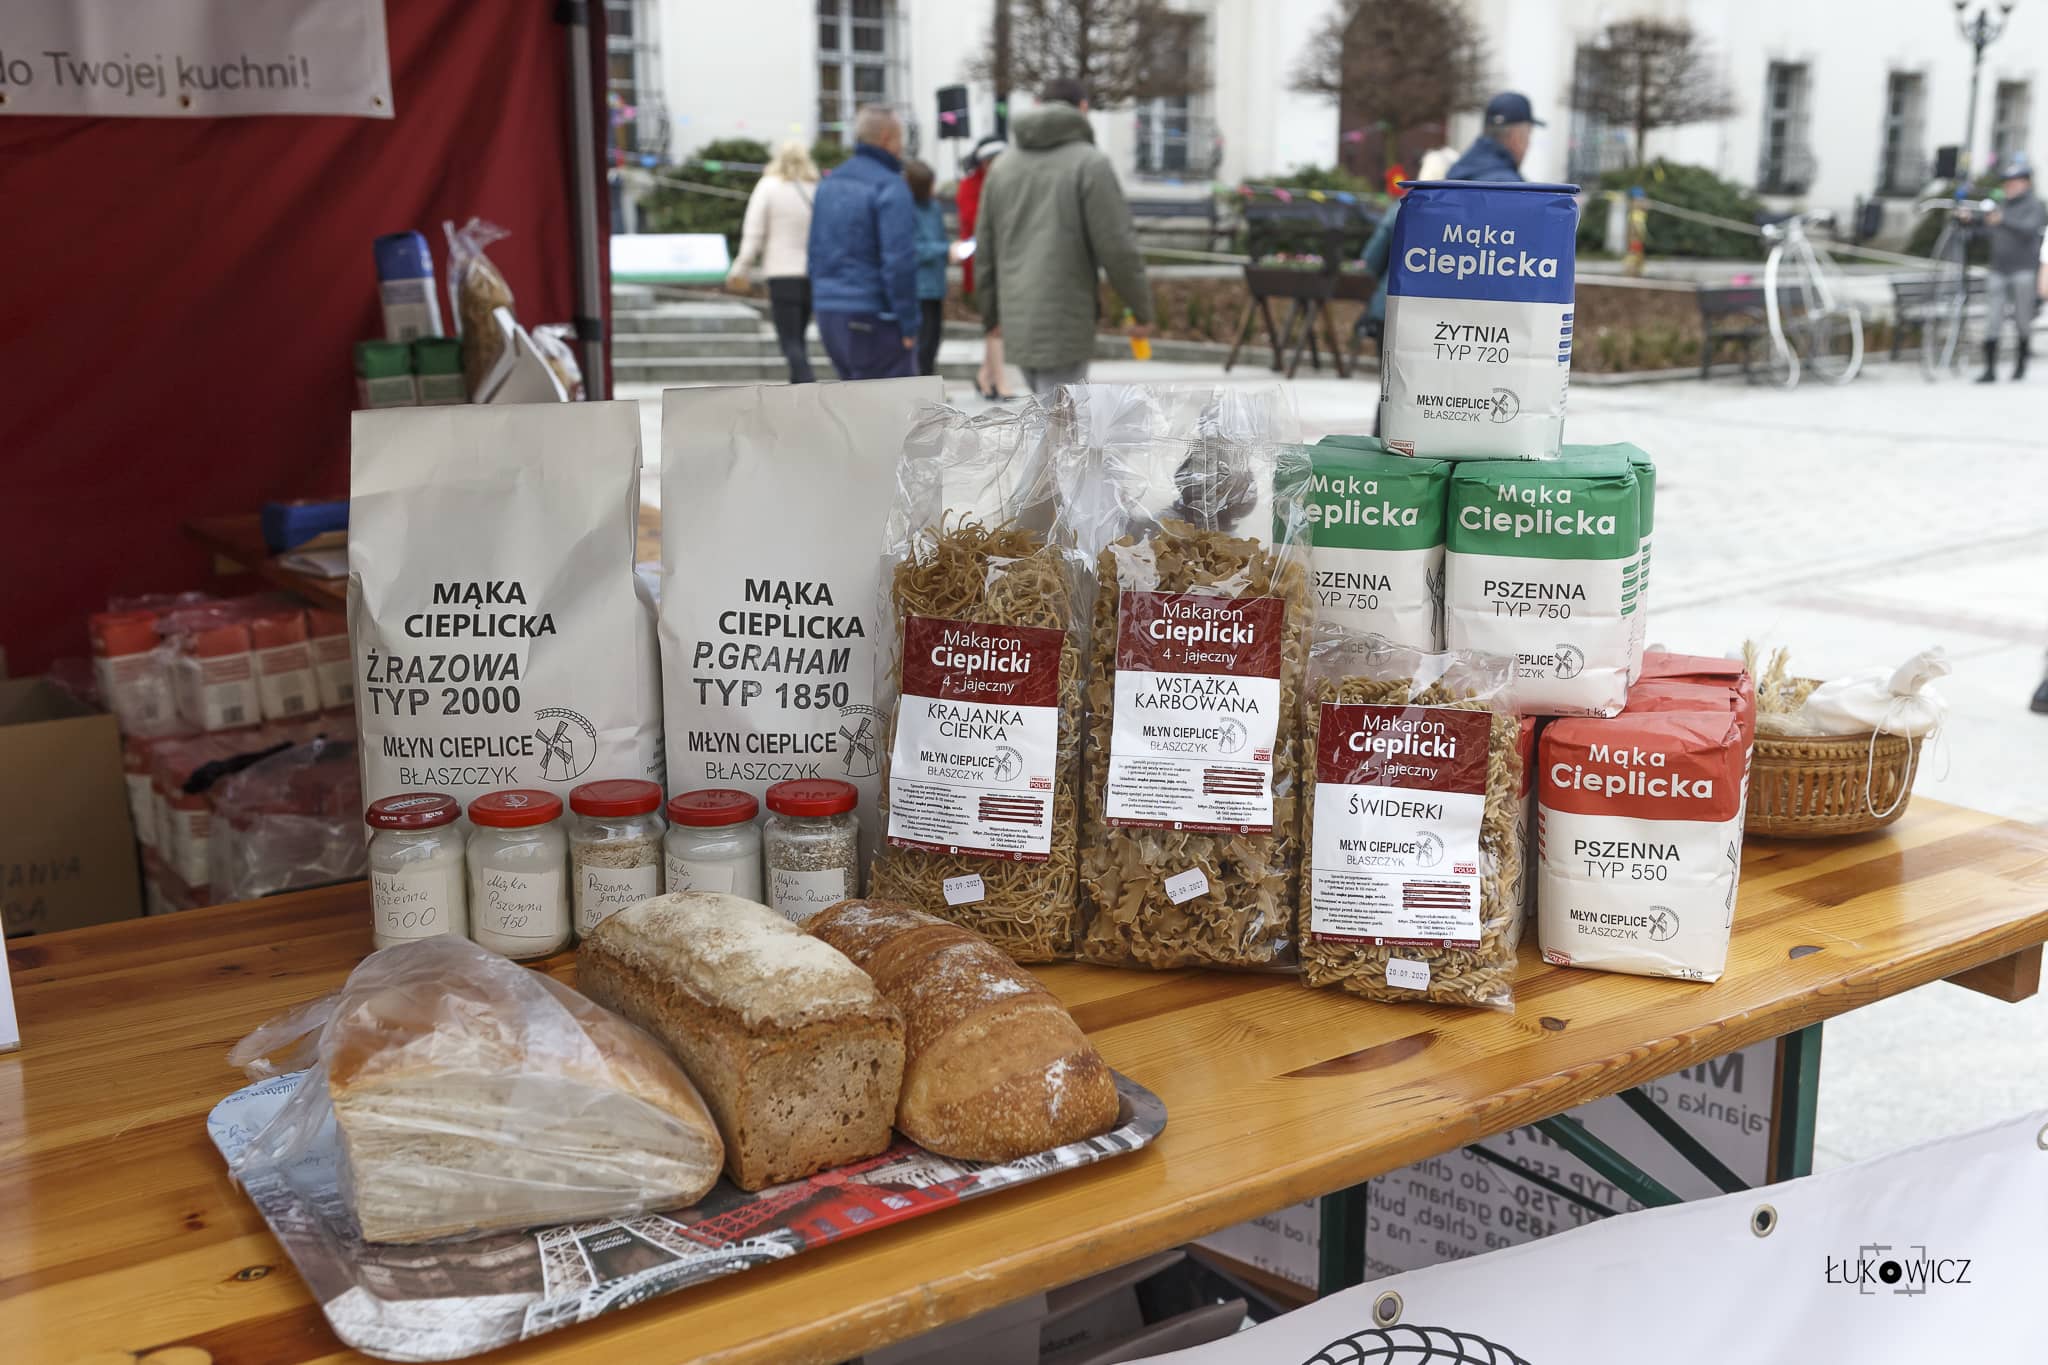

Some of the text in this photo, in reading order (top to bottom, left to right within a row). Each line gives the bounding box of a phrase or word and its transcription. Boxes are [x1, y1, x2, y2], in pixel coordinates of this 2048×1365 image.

[43, 51, 166, 97] Twojej
[176, 54, 310, 91] kuchni!
[1443, 224, 1515, 248] Mąka
[1405, 248, 1558, 280] Cieplicka
[1434, 321, 1510, 343] ŻYTNIA
[1434, 343, 1509, 364] TYP 720
[1416, 394, 1490, 410] MŁYN CIEPLICE
[1423, 410, 1480, 422] BŁASZCZYK
[1309, 475, 1378, 498] Mąka
[1497, 484, 1572, 509] Mąka
[1304, 500, 1419, 528] eplicka
[1459, 506, 1617, 537] Cieplicka
[432, 581, 527, 609] MĄKA
[744, 578, 834, 610] MĄKA
[1318, 590, 1378, 610] YP 750
[1483, 580, 1586, 600] PSZENNA
[1163, 602, 1243, 621] Makaron
[1492, 601, 1571, 620] TYP 750
[404, 613, 556, 638] CIEPLICKA
[719, 611, 865, 639] CIEPLICKA
[1150, 619, 1254, 646] Cieplicki
[943, 629, 1021, 651] Makaron
[366, 648, 520, 684] Ż.RAZOWA
[692, 641, 851, 674] P.GRAHAM
[931, 646, 1032, 675] Cieplicki
[1163, 648, 1171, 659] 4
[1183, 648, 1237, 665] jajeczny
[1518, 654, 1554, 666] EPLICE
[693, 678, 849, 709] TYP 1850
[942, 675, 950, 687] 4
[961, 676, 1015, 695] jajeczny
[1156, 676, 1239, 697] WSTĄŻKA
[368, 686, 521, 715] TYP 2000
[1135, 693, 1259, 713] KARBOWANA
[927, 703, 1024, 726] KRAJANKA
[1363, 715, 1444, 734] Makaron
[939, 721, 1007, 741] CIENKA
[1143, 726, 1218, 740] MŁYN CIEPLICE
[384, 735, 534, 757] MŁYN CIEPLICE
[688, 731, 837, 753] MŁYN CIEPLICE
[1150, 741, 1208, 752] BŁASZCZYK
[1349, 731, 1456, 759] Cieplicki
[920, 750, 994, 768] MŁYN CIEPLICE
[1589, 743, 1666, 768] Mąka
[400, 766, 519, 785] BŁASZCZYK
[706, 762, 822, 780] BŁASZCZYK
[927, 766, 984, 780] BŁASZCZYK
[1361, 761, 1369, 772] 4
[1382, 762, 1438, 780] jajeczny
[1551, 763, 1713, 799] Cieplicka
[1349, 793, 1442, 820] ŚWIDERKI
[1340, 839, 1415, 853] MŁYN CIEPLICE
[1574, 839, 1680, 861] PSZENNA
[1347, 855, 1405, 867] BŁASZCZYK
[1583, 860, 1667, 881] TYP 550
[387, 907, 437, 929] 500
[500, 913, 528, 928] 750
[1570, 909, 1648, 928] MŁYN CIEPLICE
[1578, 924, 1639, 940] BŁASZCZYK
[1681, 969, 1686, 978] 1
